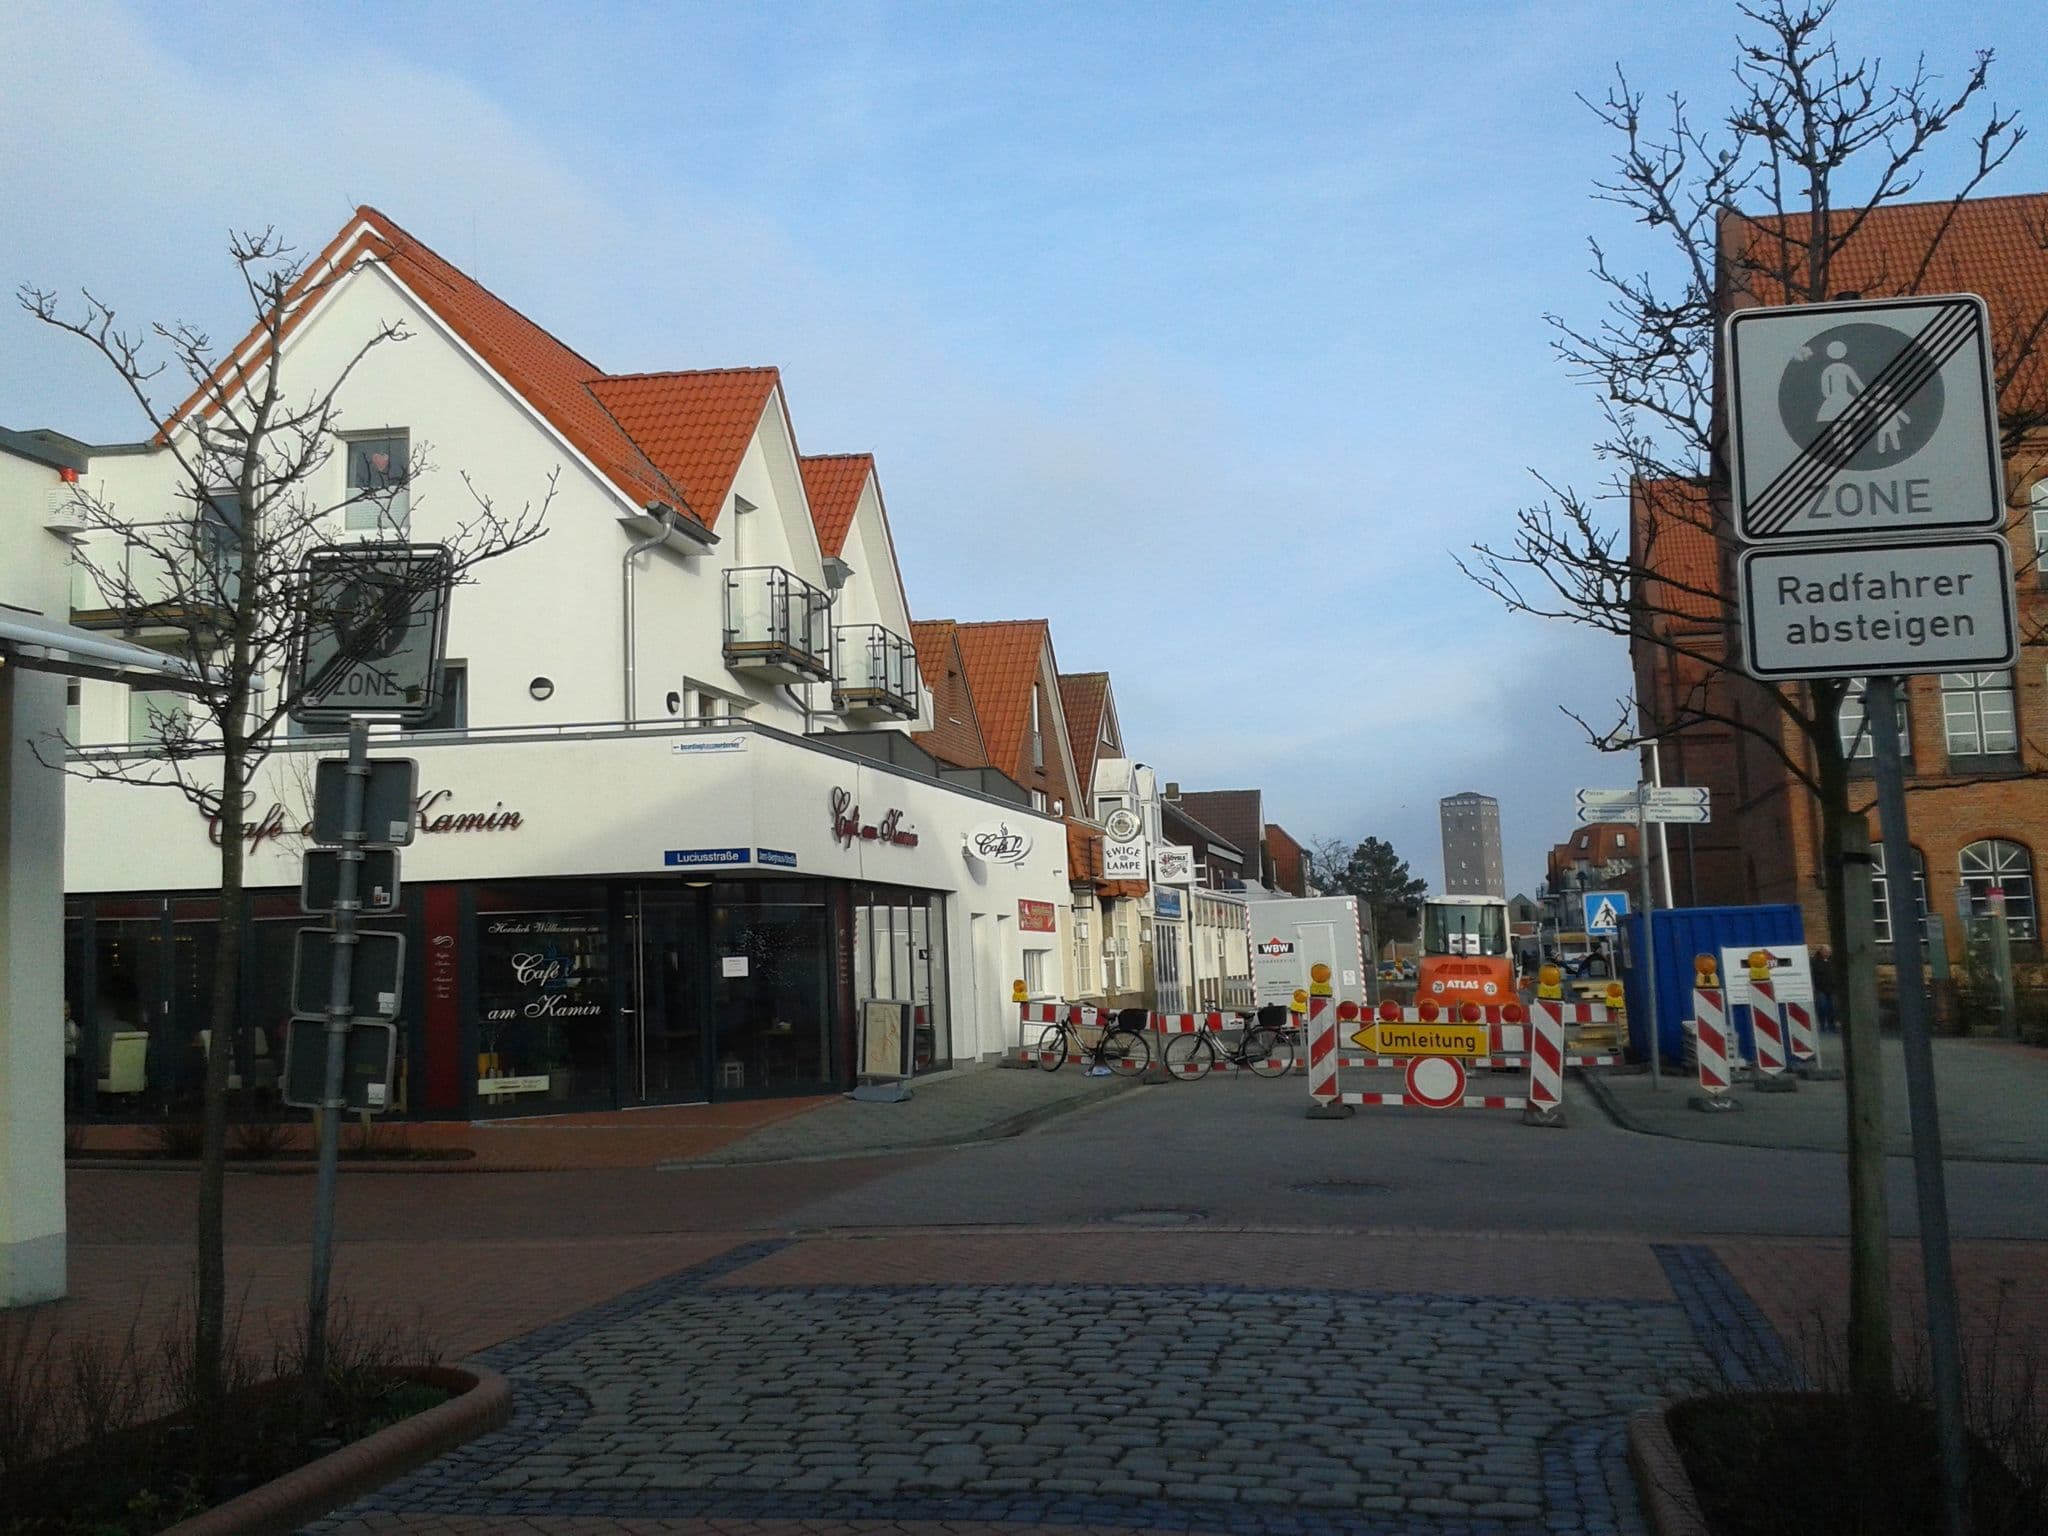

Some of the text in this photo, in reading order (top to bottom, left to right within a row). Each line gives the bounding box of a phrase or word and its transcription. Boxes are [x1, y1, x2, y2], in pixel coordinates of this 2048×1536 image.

[1806, 478, 1933, 519] ZONE
[1777, 569, 1974, 607] Radfahrer
[1786, 612, 1975, 647] absteigen
[332, 671, 398, 697] ZONE
[413, 789, 524, 834] Kamin
[676, 850, 740, 863] Luciusstraße
[1105, 845, 1141, 858] EWIGE
[1106, 861, 1141, 870] LAMPE
[1262, 944, 1289, 953] WBW
[511, 952, 560, 986] Café
[1446, 980, 1479, 989] ATLAS
[487, 994, 601, 1020] am Kamin
[1381, 1031, 1476, 1052] Umleitung
